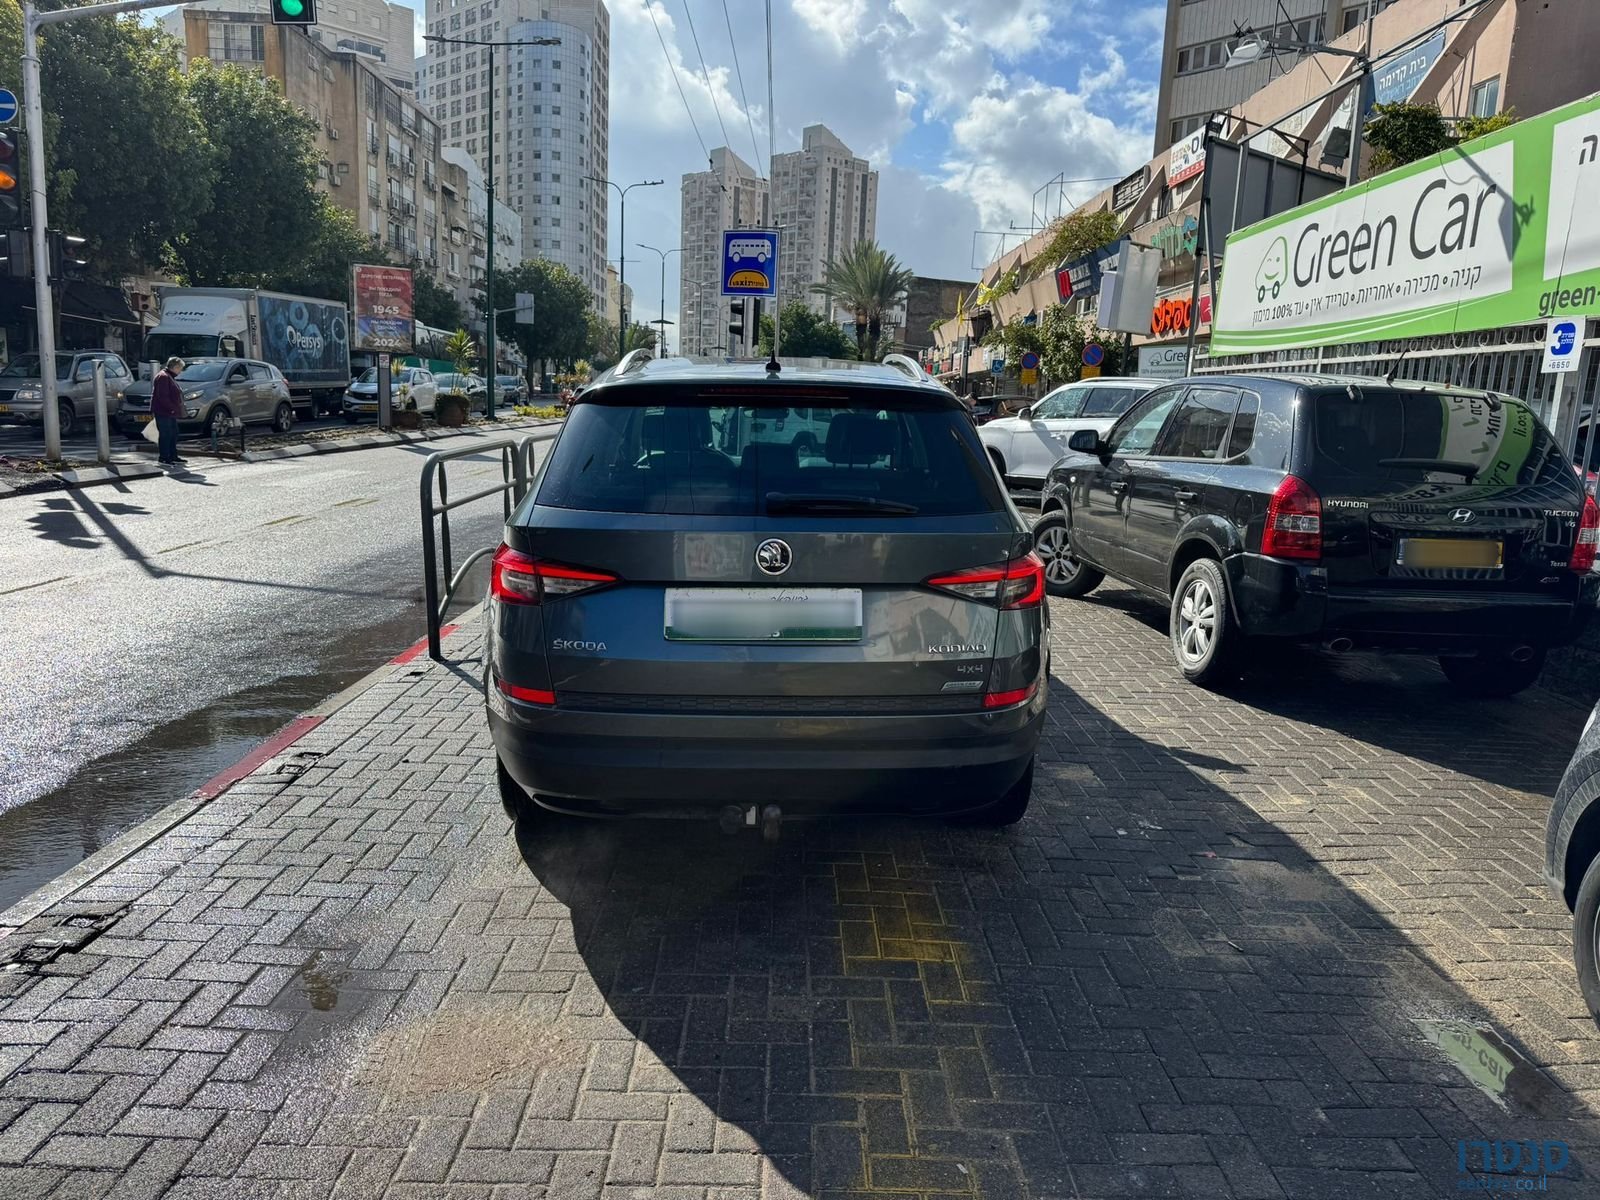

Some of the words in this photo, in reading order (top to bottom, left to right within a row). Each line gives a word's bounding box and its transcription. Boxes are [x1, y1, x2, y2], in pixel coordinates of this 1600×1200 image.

[1409, 56, 1426, 74] בית
[1379, 65, 1407, 90] קדימה
[1293, 215, 1398, 288] Green
[1409, 178, 1497, 260] Car
[1403, 273, 1439, 296] מכירה
[1450, 266, 1482, 290] קניה
[1325, 292, 1349, 310] טרייד
[1356, 282, 1395, 304] אחריות
[372, 305, 400, 315] 1945
[1272, 303, 1293, 320] 100%
[1295, 301, 1305, 315] עד
[1310, 297, 1323, 317] אין
[1252, 308, 1270, 327] מימון
[373, 338, 401, 347] 2024
[1327, 499, 1369, 509] HYUNDAI
[1543, 509, 1580, 517] TUCSON
[553, 637, 607, 651] ŠKODA
[928, 644, 987, 653] KODIAQ
